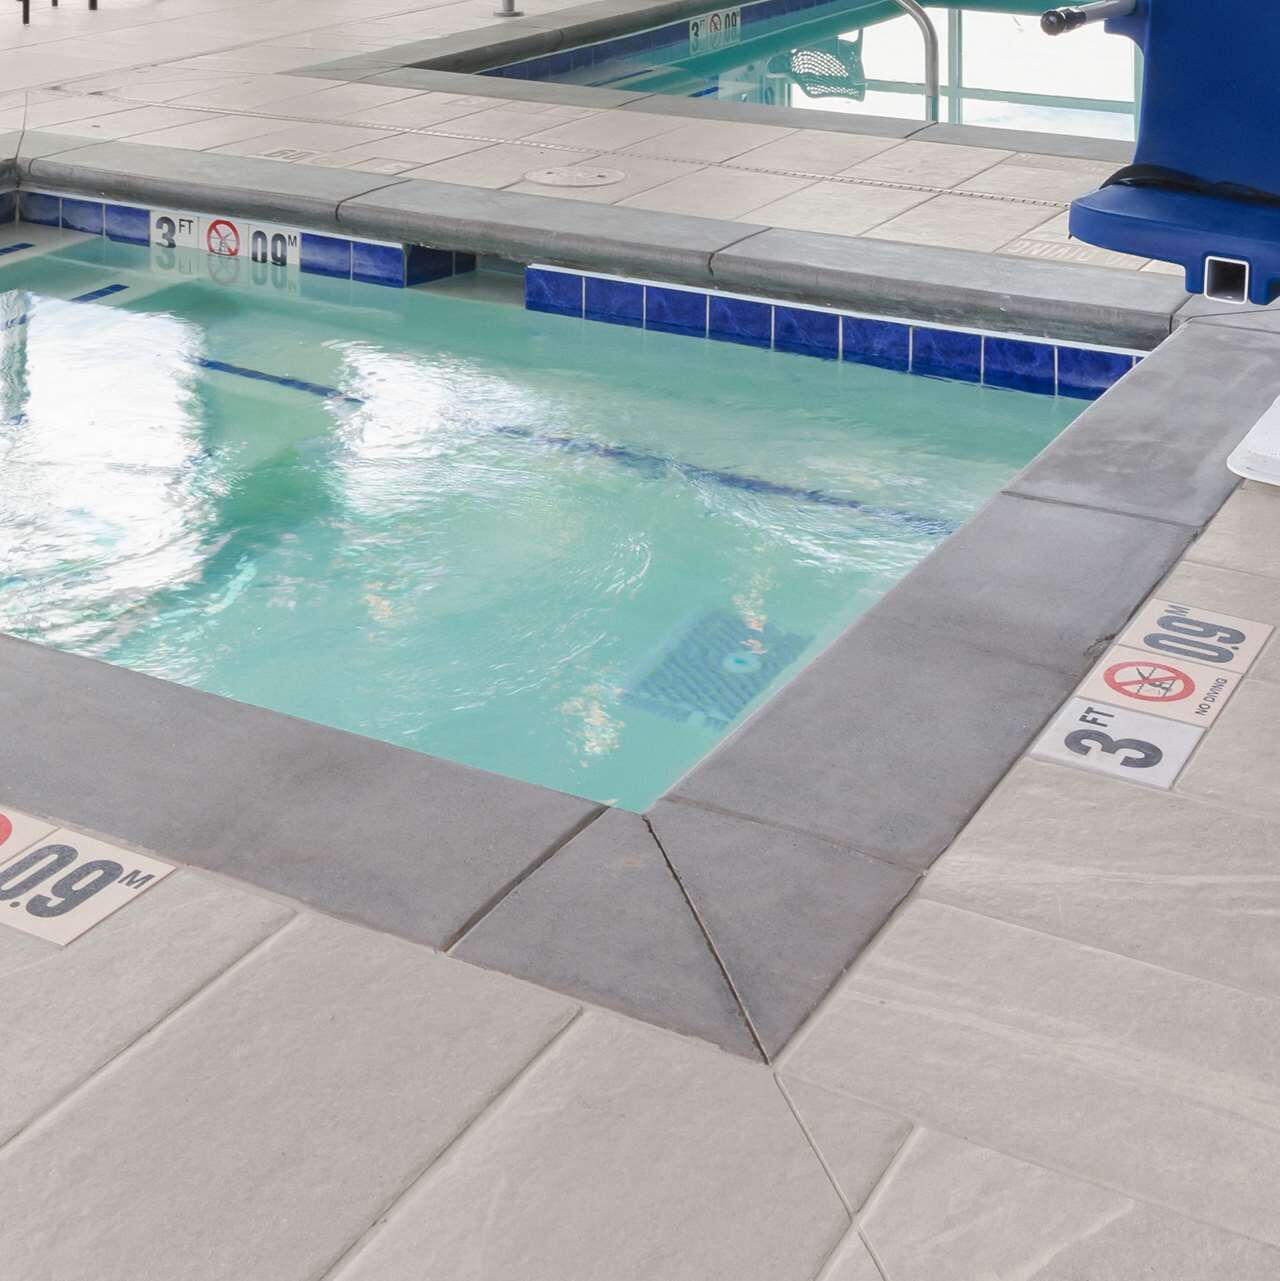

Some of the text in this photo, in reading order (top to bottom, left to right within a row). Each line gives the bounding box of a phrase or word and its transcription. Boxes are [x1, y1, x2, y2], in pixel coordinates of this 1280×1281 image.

[155, 216, 176, 249] 3
[178, 218, 194, 235] FT
[288, 234, 297, 248] M
[1143, 604, 1247, 664] 0.9 M
[1195, 677, 1227, 716] NO DIVING
[1064, 706, 1163, 768] 3 FT
[119, 868, 155, 891] M
